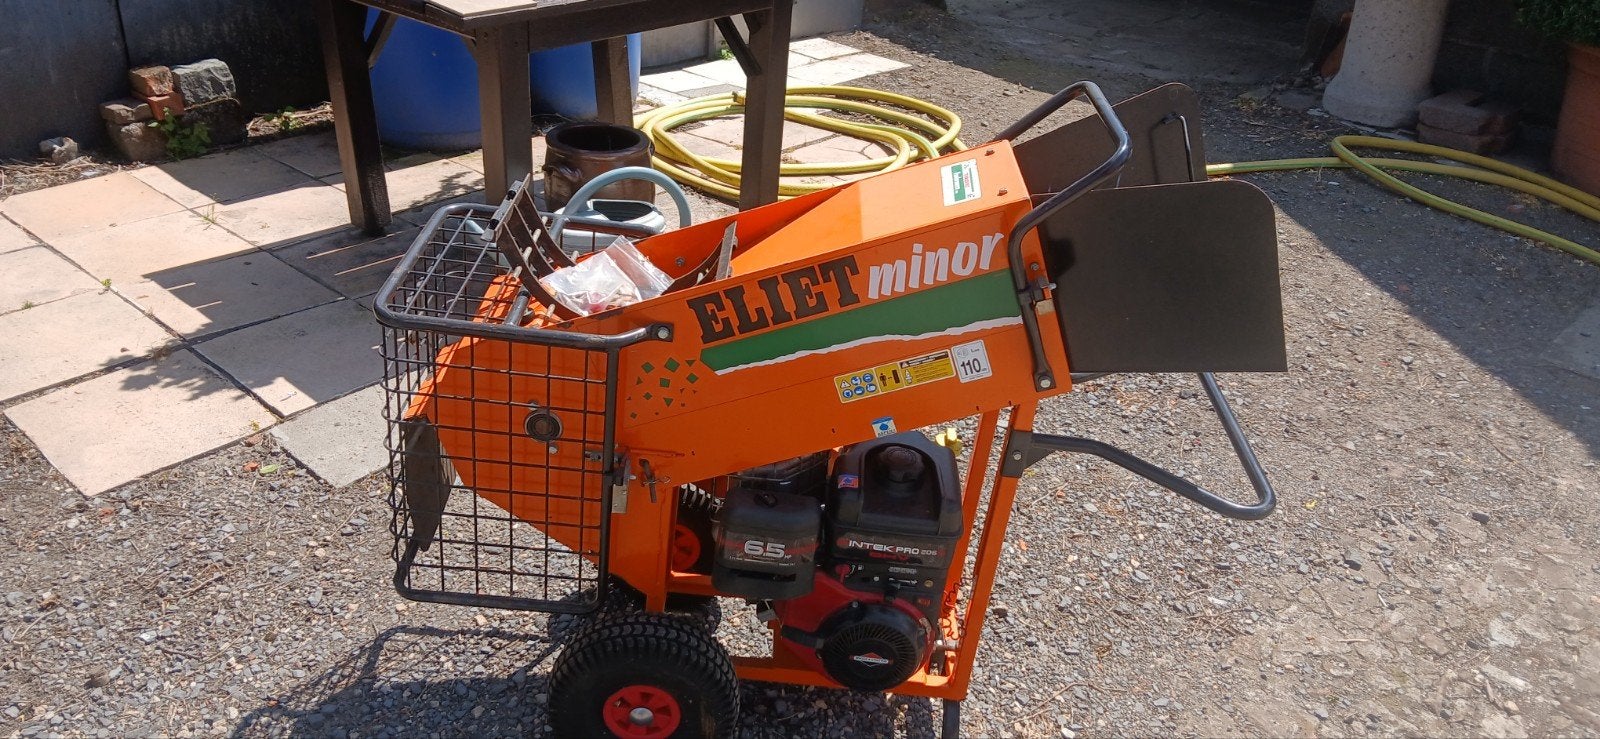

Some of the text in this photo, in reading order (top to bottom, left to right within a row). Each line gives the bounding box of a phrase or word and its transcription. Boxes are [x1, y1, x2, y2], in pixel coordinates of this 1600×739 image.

[687, 232, 1004, 344] ELIET minor
[960, 357, 981, 376] 110
[848, 540, 895, 553] INTEK
[895, 546, 920, 555] PRO
